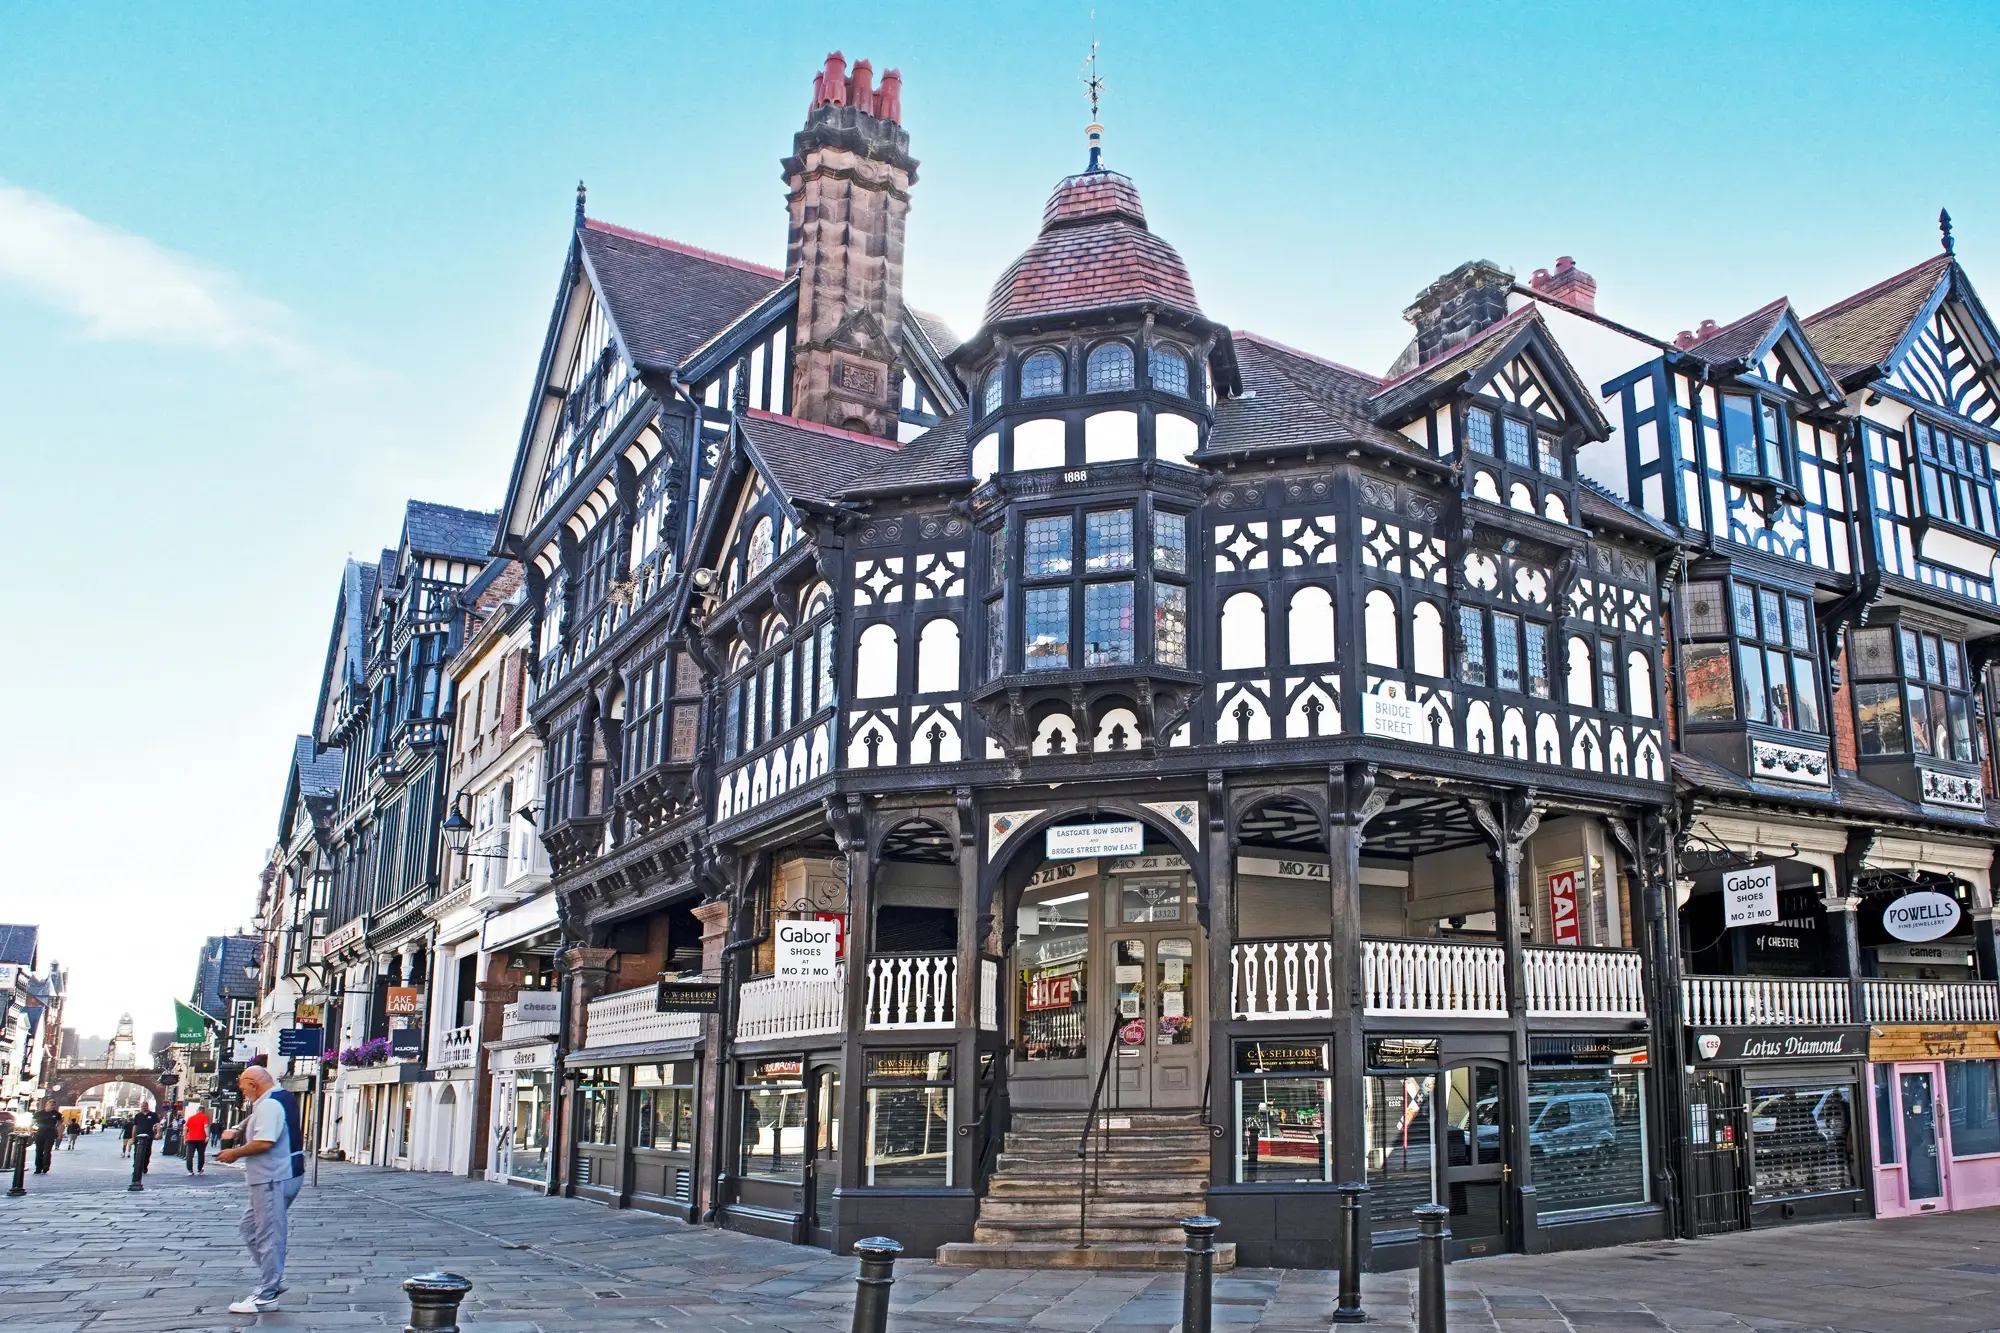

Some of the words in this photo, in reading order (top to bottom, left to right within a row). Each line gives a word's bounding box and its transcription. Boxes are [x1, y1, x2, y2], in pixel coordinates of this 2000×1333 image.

[1064, 470, 1087, 482] 1888
[1376, 702, 1411, 718] BRIDGE
[1375, 718, 1412, 734] STREET
[1056, 828, 1090, 837] EASTGATE
[1113, 859, 1136, 870] MO
[1142, 858, 1158, 868] ZI
[1278, 861, 1304, 876] MO
[1308, 864, 1324, 877] ZI
[1042, 868, 1055, 883] ZI
[1057, 864, 1076, 879] MO
[1728, 876, 1771, 892] Gabor
[1737, 892, 1764, 902] SHOES
[1758, 910, 1772, 918] MO
[1890, 902, 1953, 923] POWELLS
[1913, 920, 1945, 928] JEWELLERY
[780, 927, 831, 943] Gabor
[1756, 936, 1765, 950] of
[1768, 937, 1799, 948] CHESTER
[1910, 947, 1942, 958] camera
[388, 996, 412, 1004] LAKE
[1029, 980, 1070, 1006] SALE
[388, 1004, 414, 1012] LAND
[1742, 1038, 1781, 1056] Lotus
[1785, 1034, 1844, 1054] Diamond
